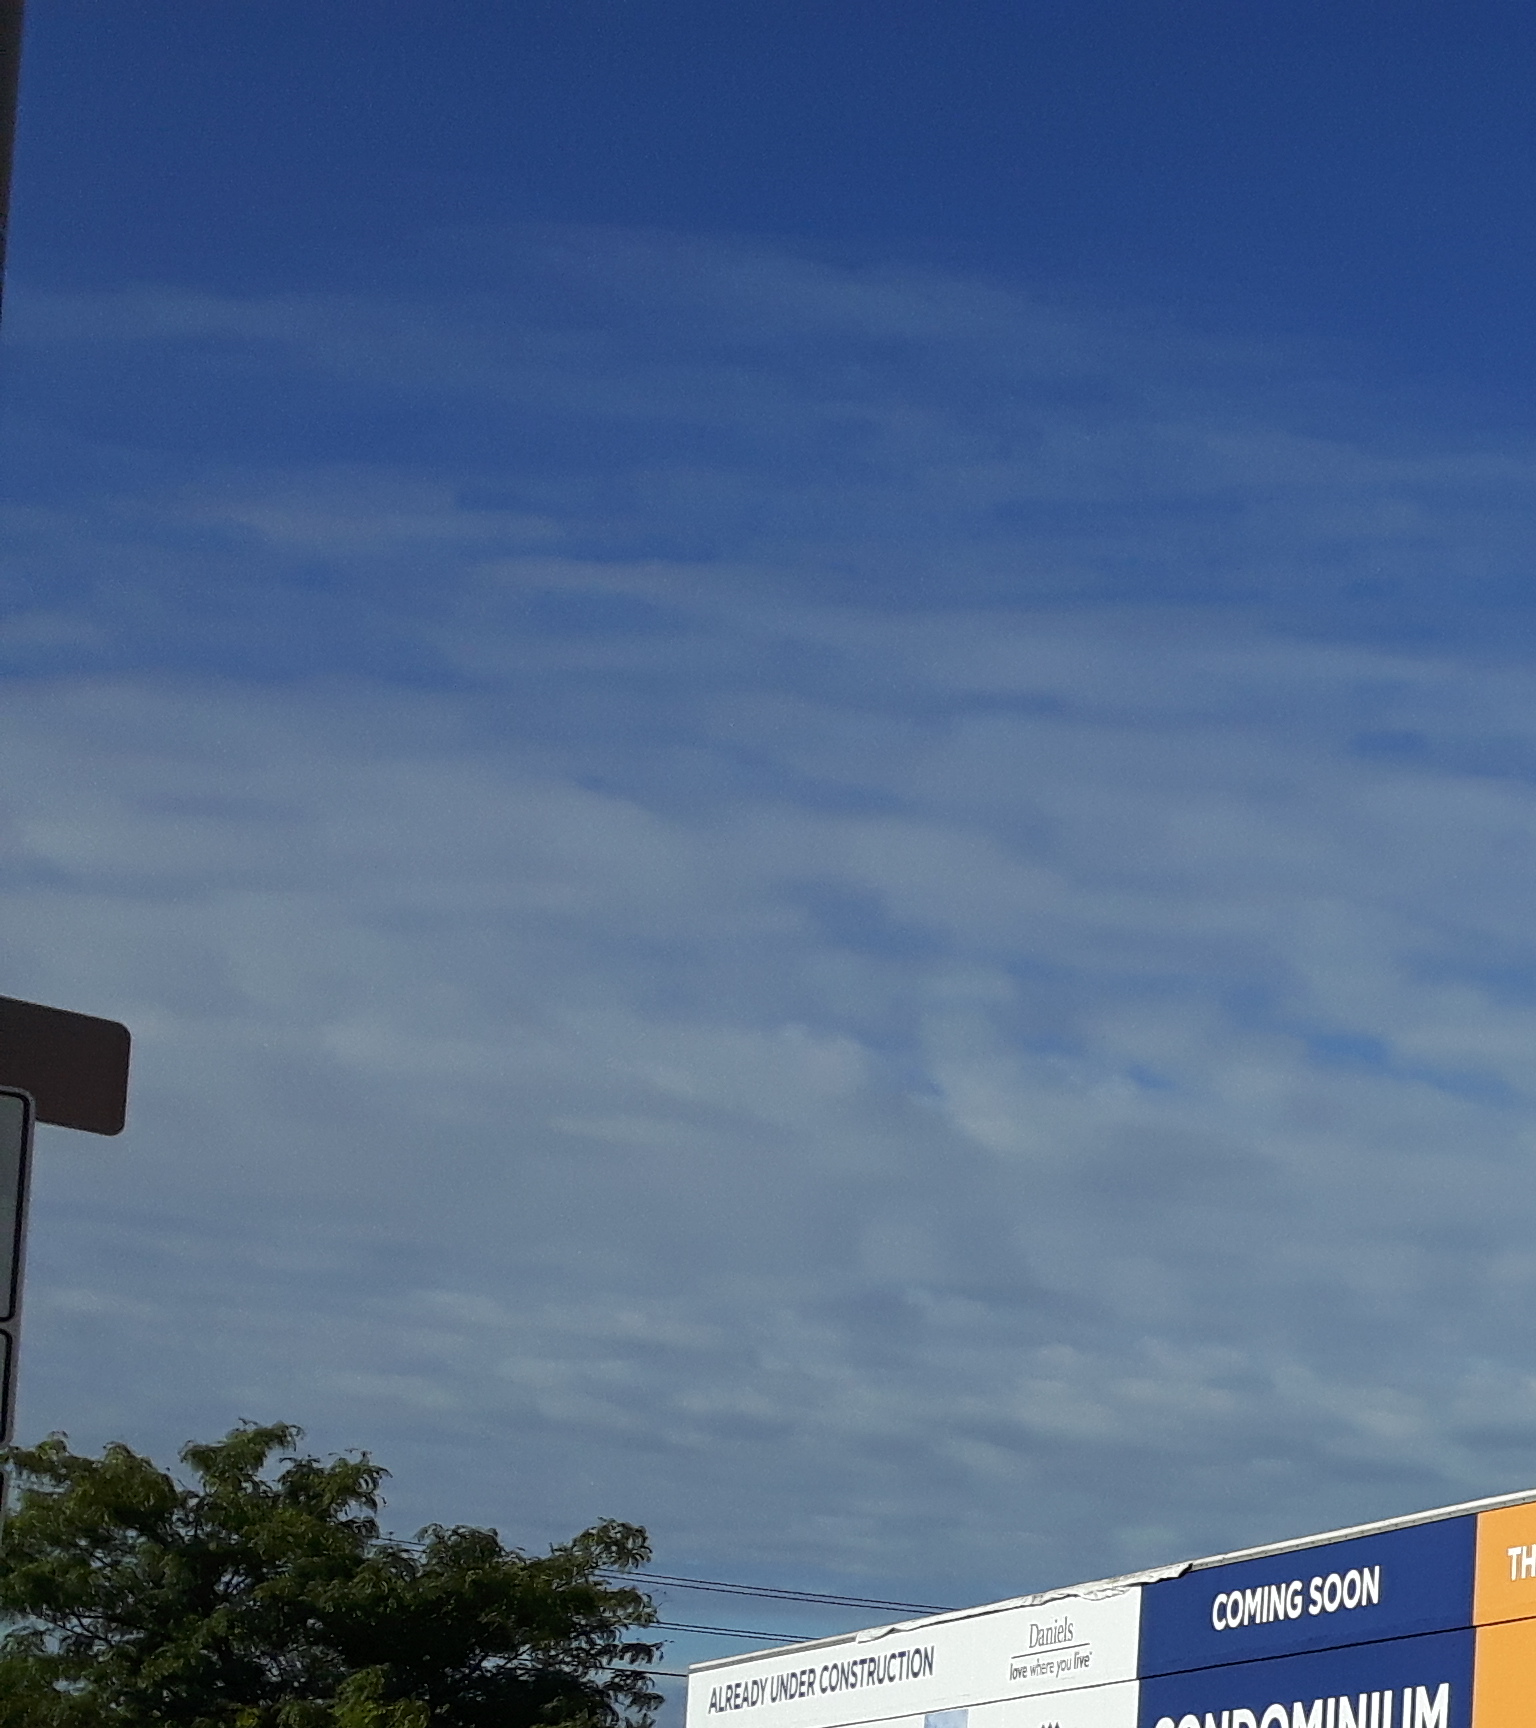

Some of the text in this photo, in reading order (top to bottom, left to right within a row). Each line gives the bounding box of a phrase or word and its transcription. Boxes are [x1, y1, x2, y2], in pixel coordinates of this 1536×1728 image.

[1213, 1566, 1379, 1630] COMING SOON
[1029, 1616, 1074, 1648] Daniels
[708, 1645, 935, 1714] ALREADY UNDER CONSTRUCTION
[1009, 1663, 1028, 1681] love
